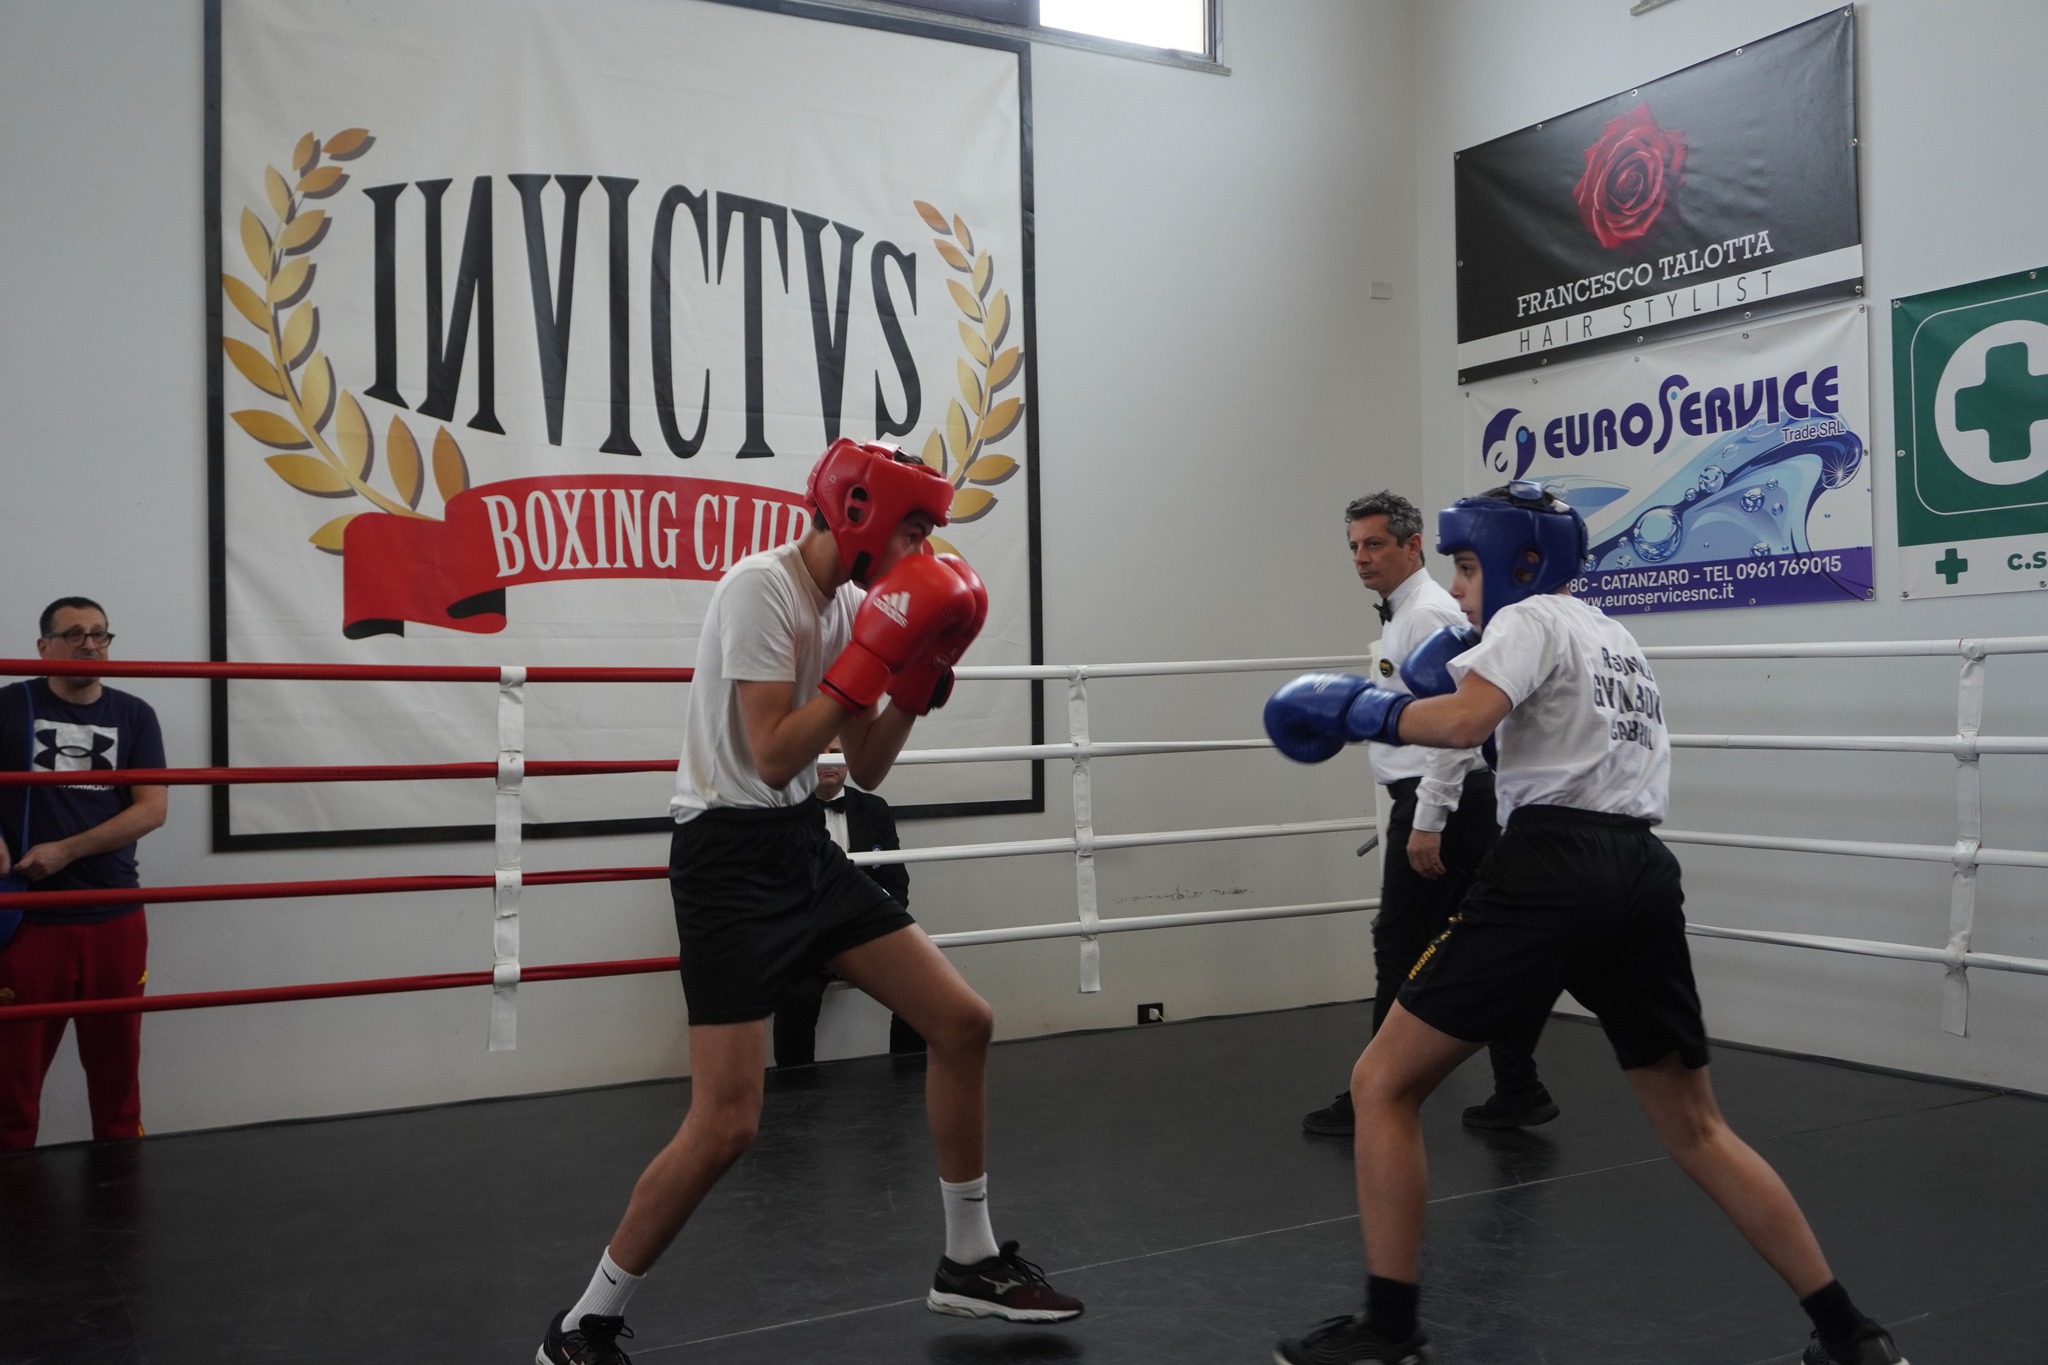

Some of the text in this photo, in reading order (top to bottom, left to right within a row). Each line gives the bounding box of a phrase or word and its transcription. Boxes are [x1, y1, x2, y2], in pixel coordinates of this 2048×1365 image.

[1516, 230, 1774, 318] FRANCESCO TALOTTA
[1519, 270, 1773, 353] HAIR STYLIST
[1781, 420, 1845, 442] Trade SRL
[481, 488, 680, 578] BOXING
[1566, 577, 1589, 593] 8C
[1601, 568, 1690, 591] CATANZARO
[1703, 564, 1734, 582] TEL
[1736, 560, 1776, 580] 0961
[1779, 555, 1842, 577] 769015
[1579, 583, 1735, 608] ww.euroservicesnc.it
